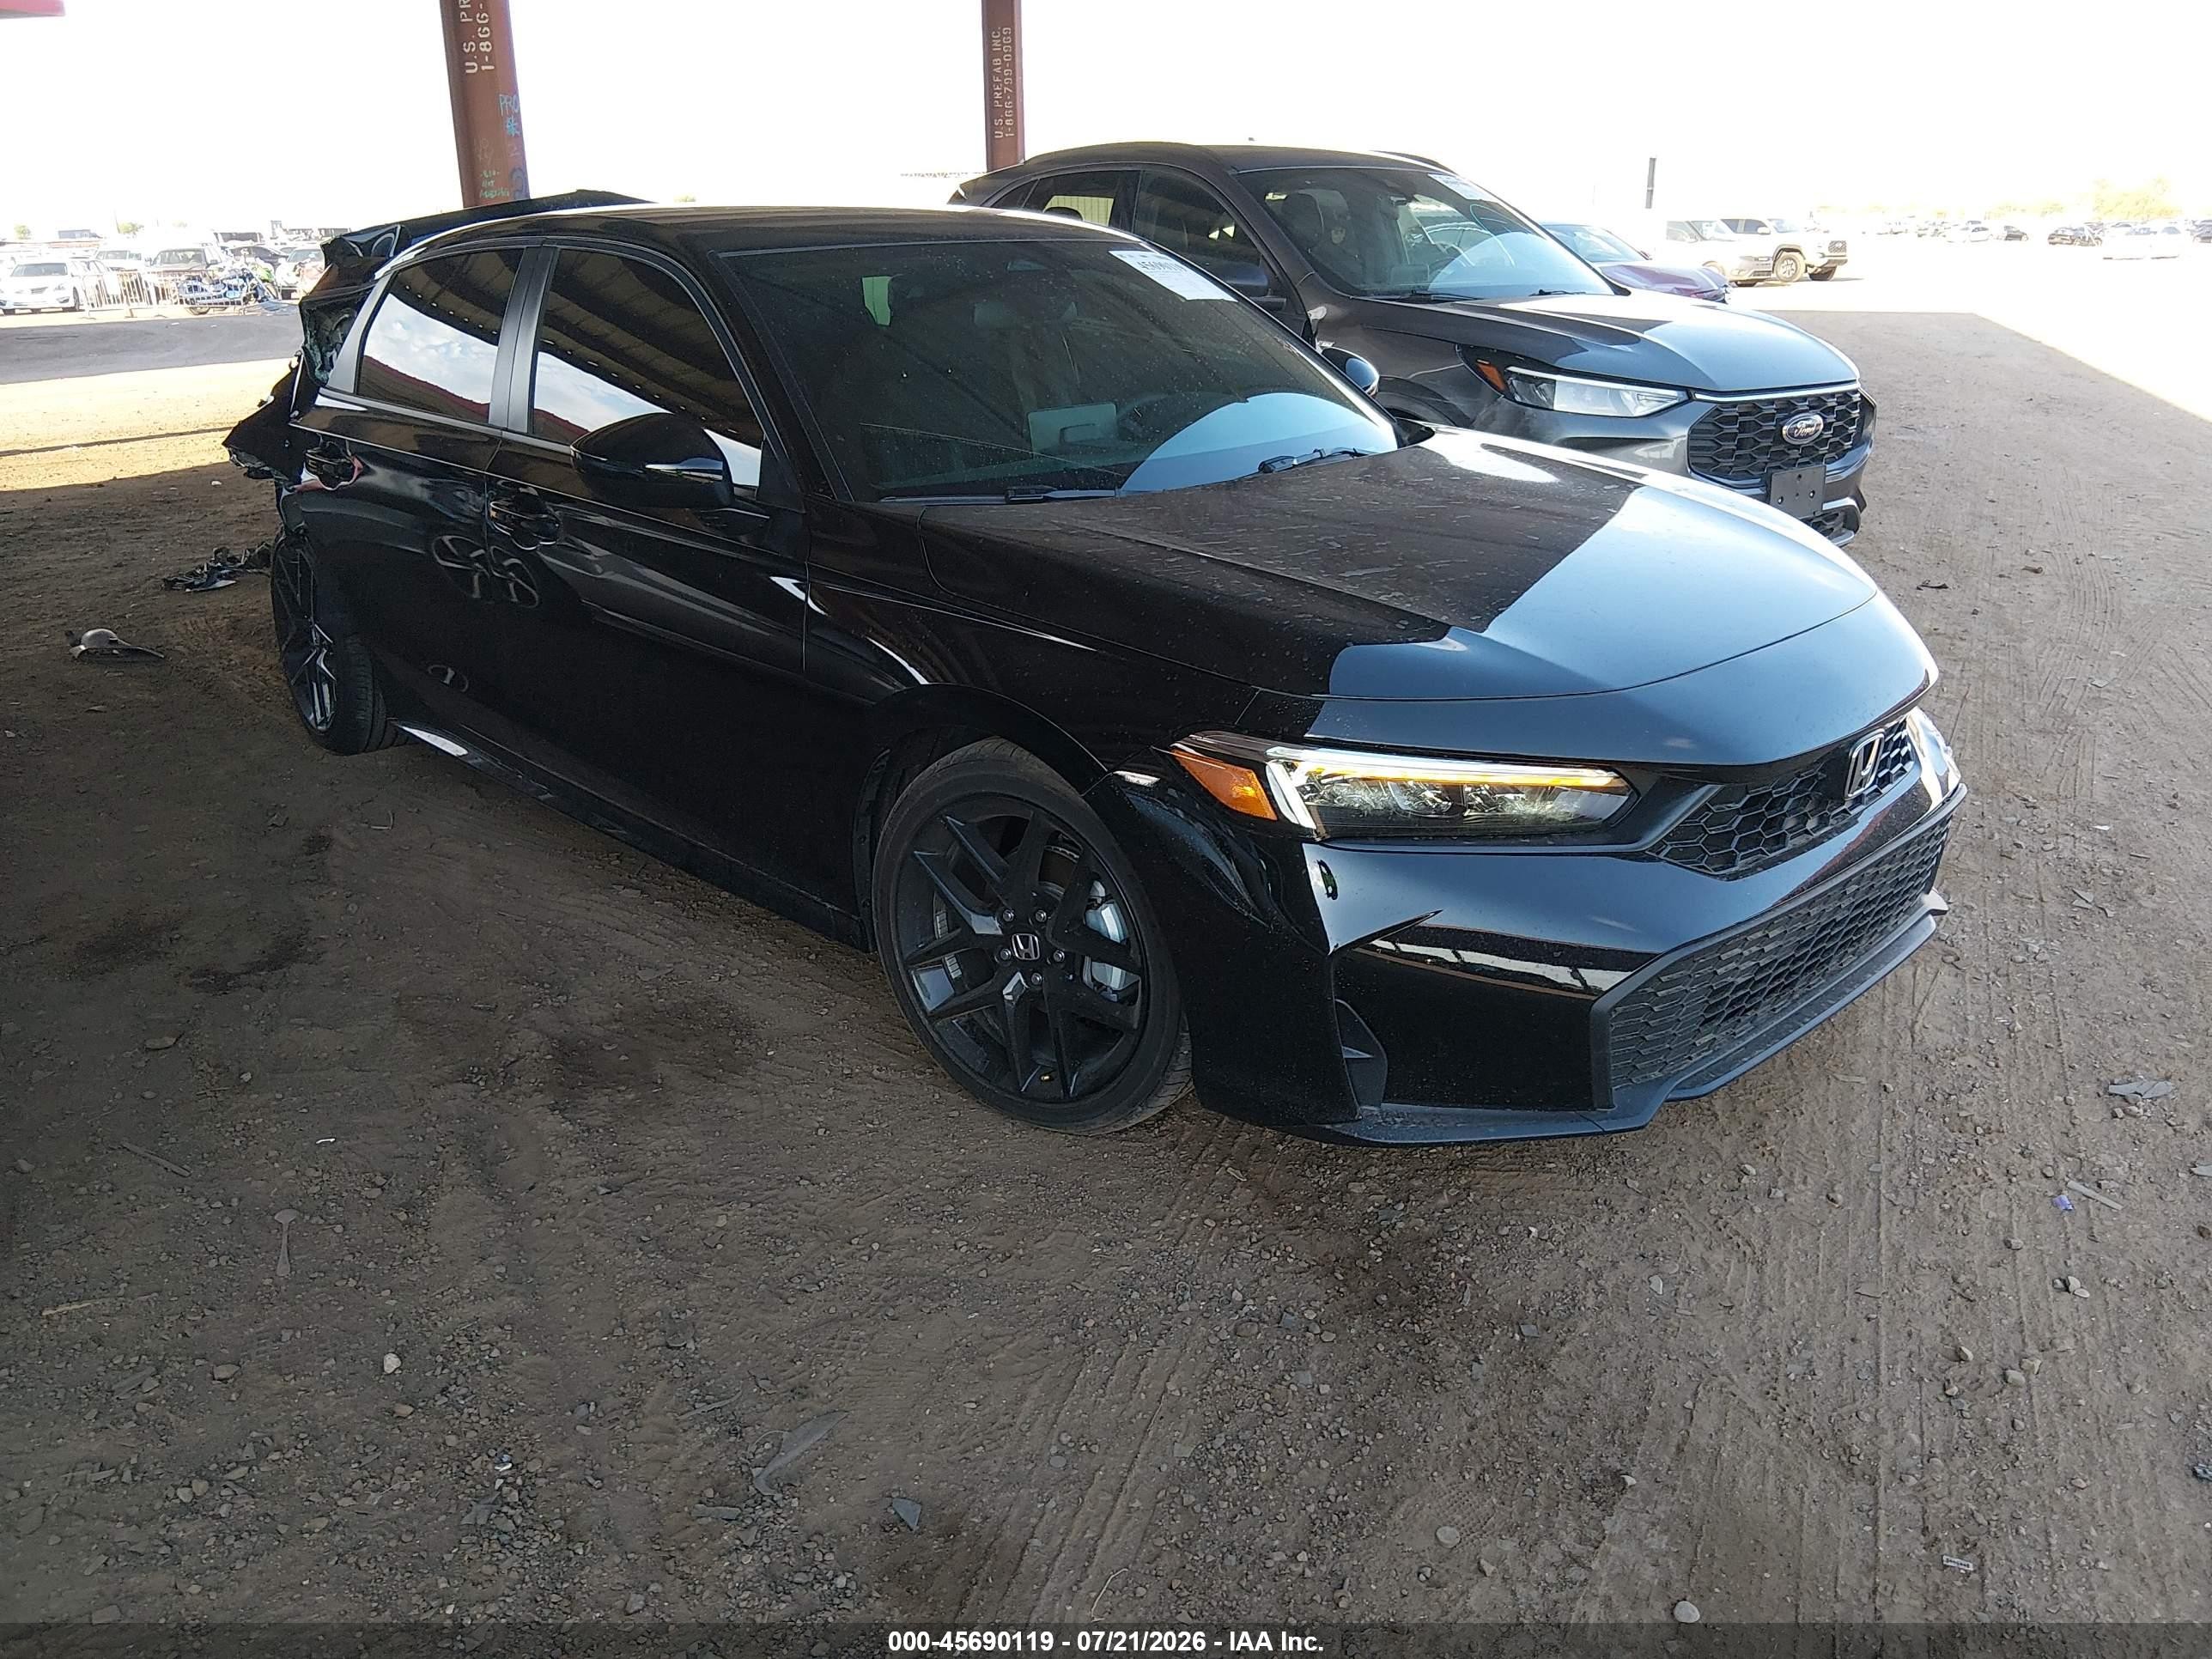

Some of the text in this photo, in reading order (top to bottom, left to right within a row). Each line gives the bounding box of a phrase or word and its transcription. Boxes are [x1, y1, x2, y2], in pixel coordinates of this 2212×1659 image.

[463, 35, 478, 74] U.S.
[992, 27, 1004, 139] U.S. PREFAB INC.
[1003, 27, 1015, 137] 1-866-799-0969
